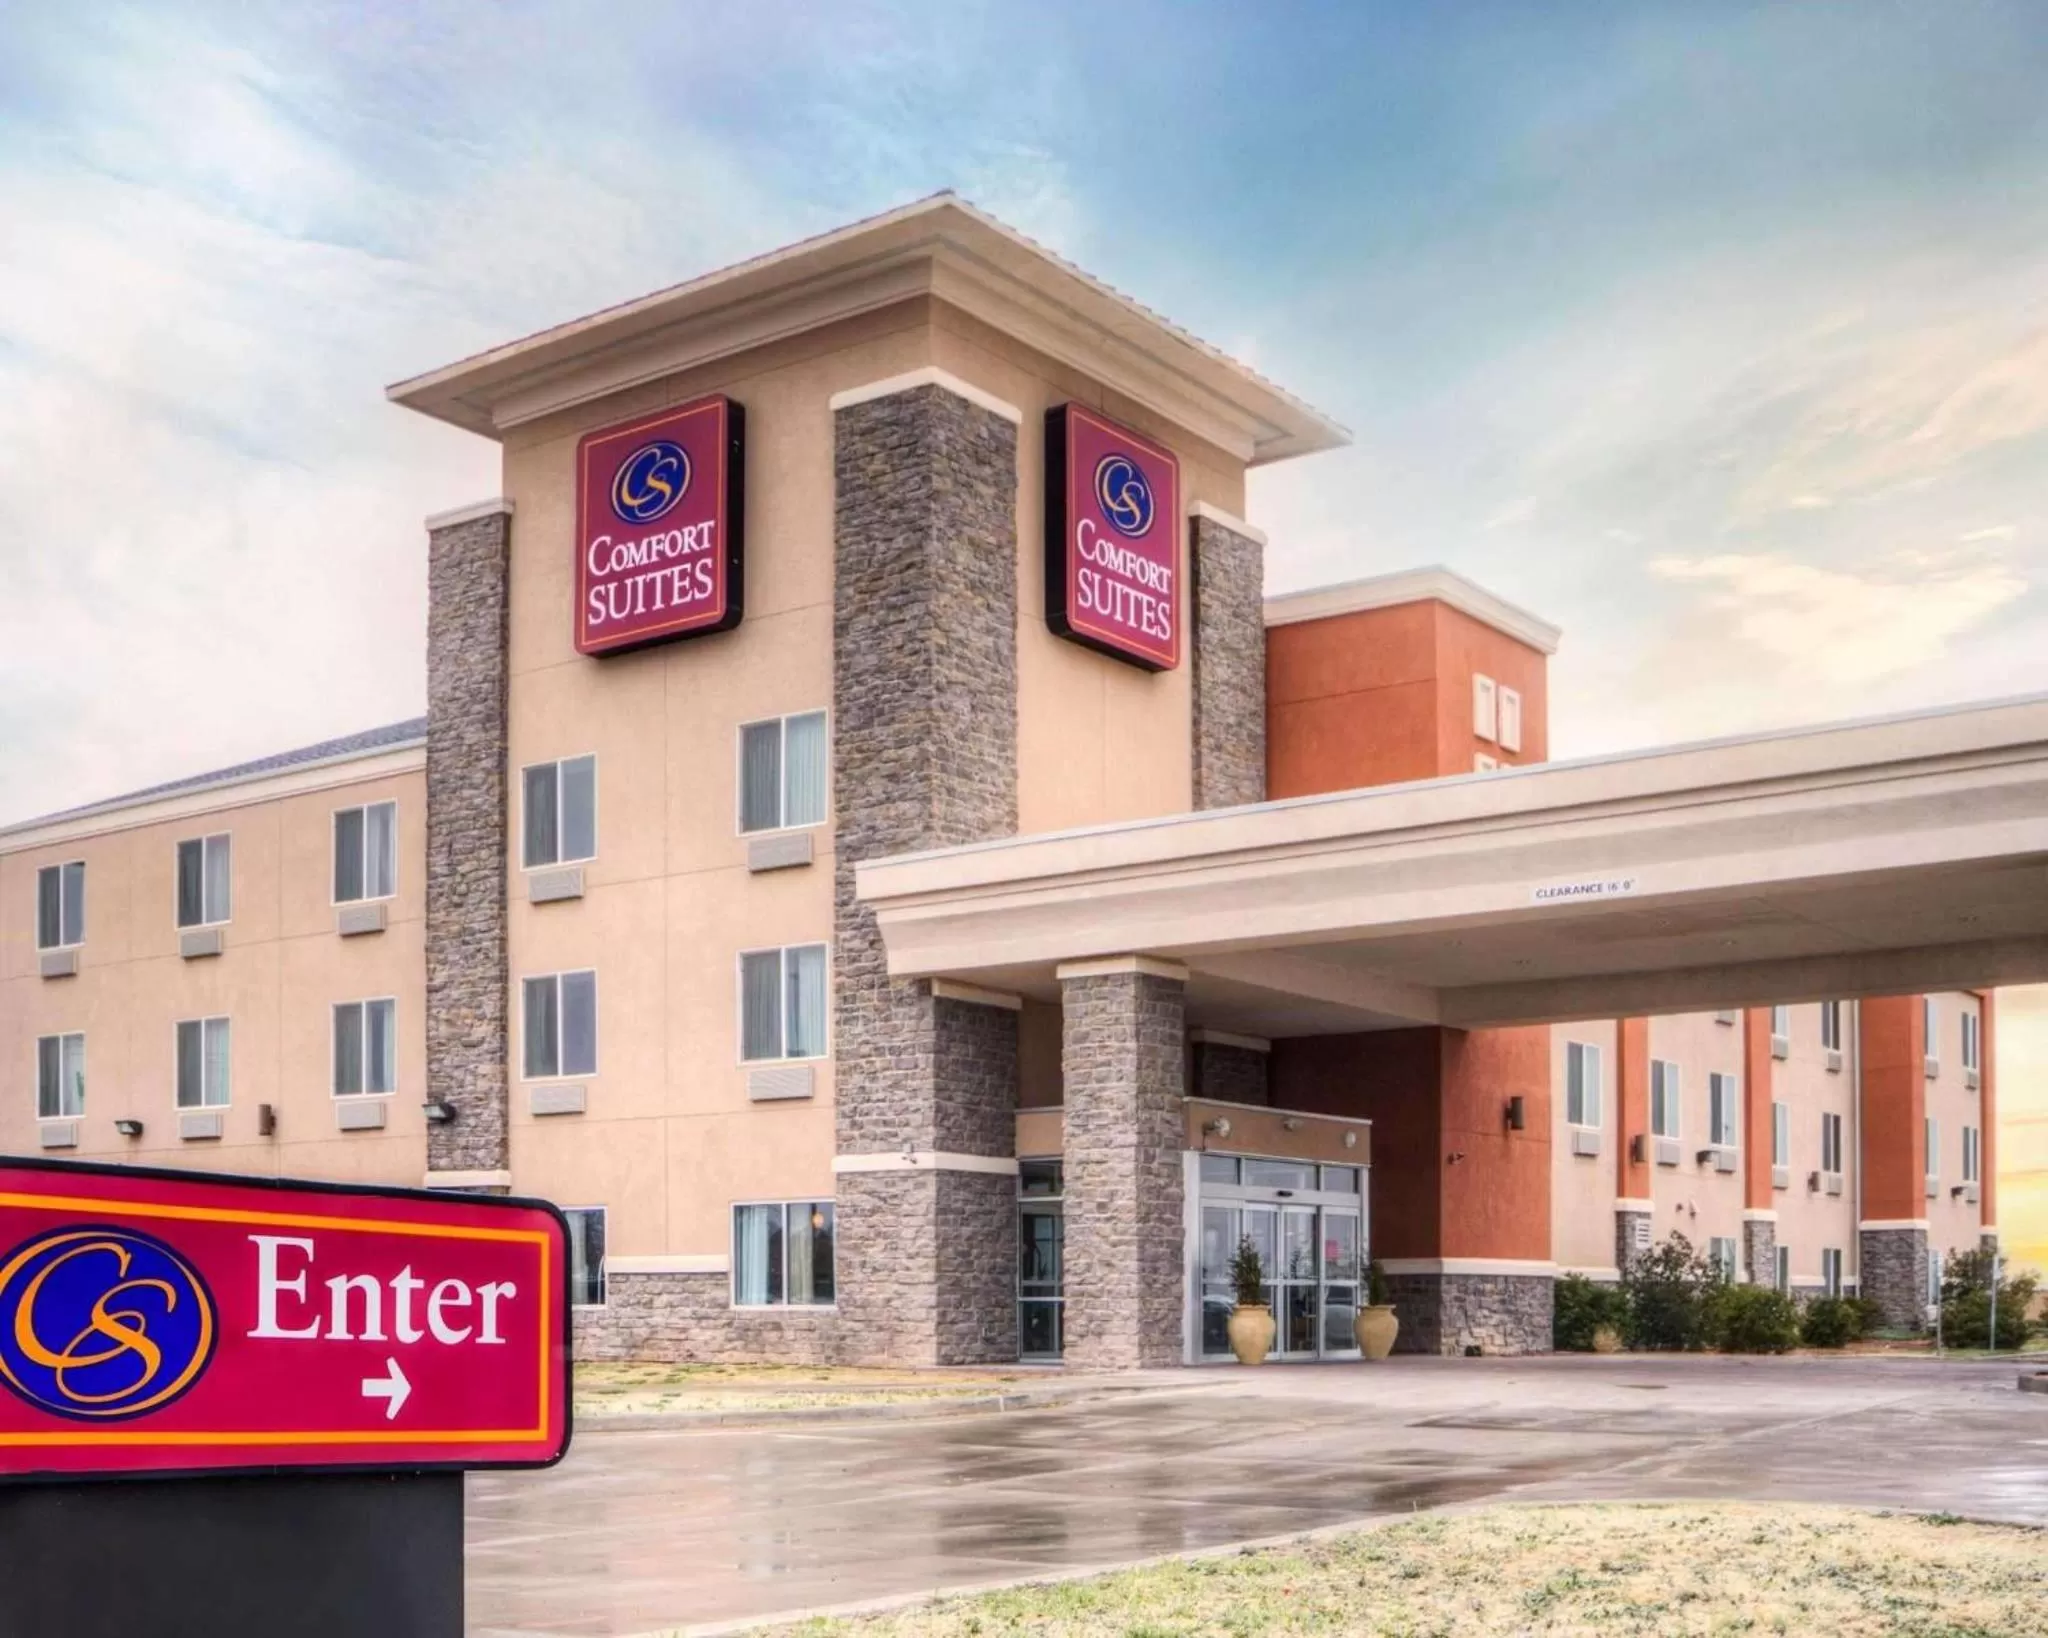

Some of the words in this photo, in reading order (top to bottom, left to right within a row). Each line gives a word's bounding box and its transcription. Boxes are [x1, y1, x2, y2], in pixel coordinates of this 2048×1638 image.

[588, 520, 715, 576] COMFORT
[1076, 518, 1171, 594] COMFORT
[588, 558, 713, 625] SUITES
[1077, 567, 1171, 641] SUITES
[1535, 882, 1604, 899] CLEARANCE
[247, 1234, 517, 1345] Enter
